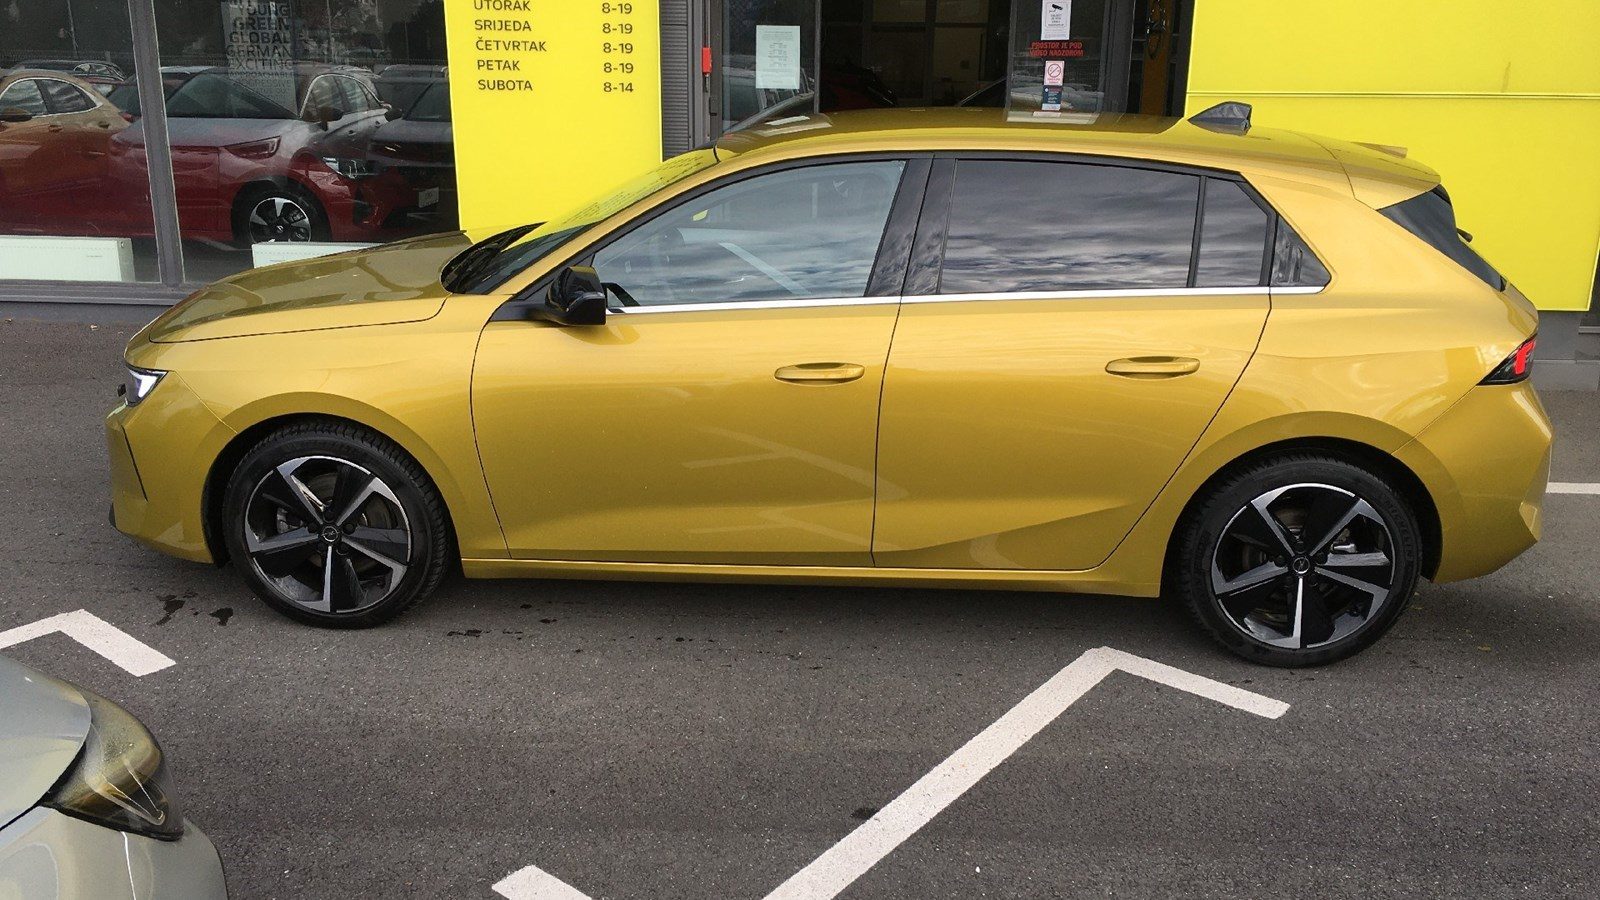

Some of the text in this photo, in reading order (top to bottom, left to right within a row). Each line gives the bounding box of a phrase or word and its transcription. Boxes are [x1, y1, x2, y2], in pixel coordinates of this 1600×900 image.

[239, 4, 290, 16] YOUNG
[474, 0, 633, 14] UTORAK 8-19
[233, 17, 290, 31] GREEN
[474, 20, 633, 34] SRIJEDA 8-19
[229, 31, 291, 44] GLOBAL
[226, 45, 292, 58] GERMAN
[476, 37, 633, 54] ČETVRTAK 8-19
[229, 58, 294, 70] EXCITING
[477, 60, 634, 73] PETAK 8-19
[478, 79, 634, 93] SUBOTA 8-14
